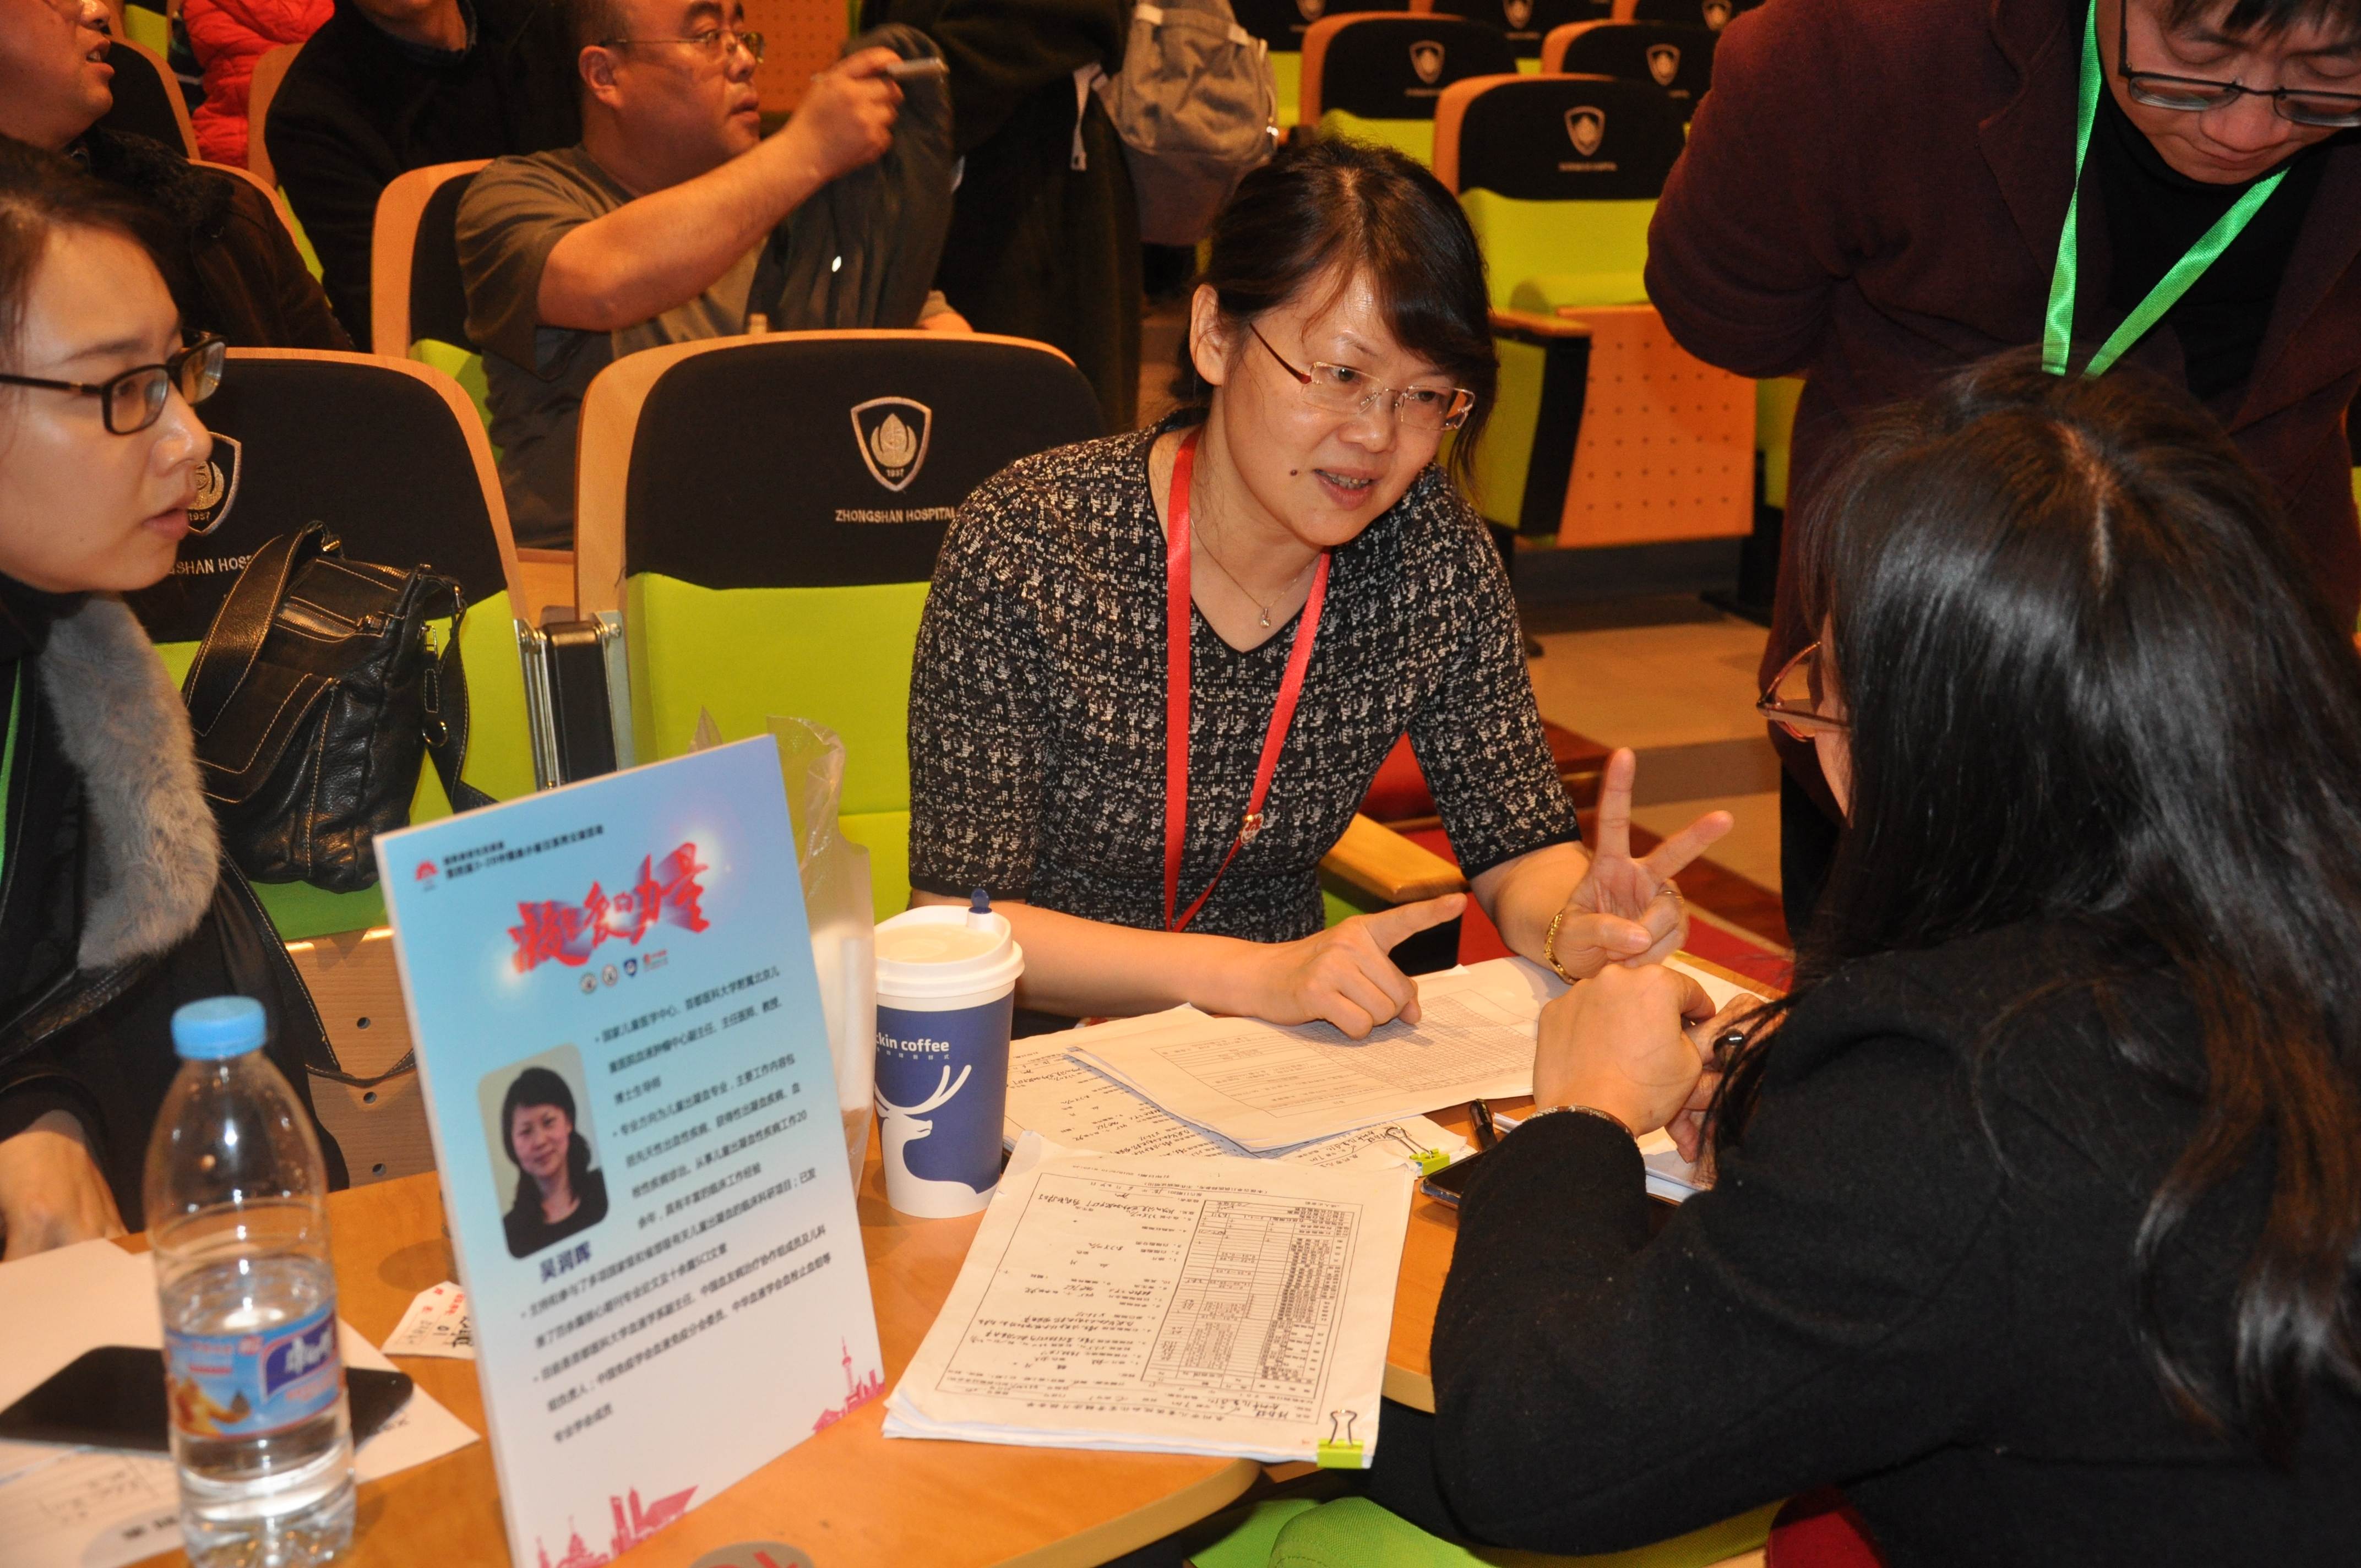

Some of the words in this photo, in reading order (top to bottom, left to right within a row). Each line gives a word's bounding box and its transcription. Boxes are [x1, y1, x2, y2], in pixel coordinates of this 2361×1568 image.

[835, 509, 904, 524] ZHONGSHAN
[168, 559, 214, 575] SHAN
[901, 1038, 950, 1052] coffee
